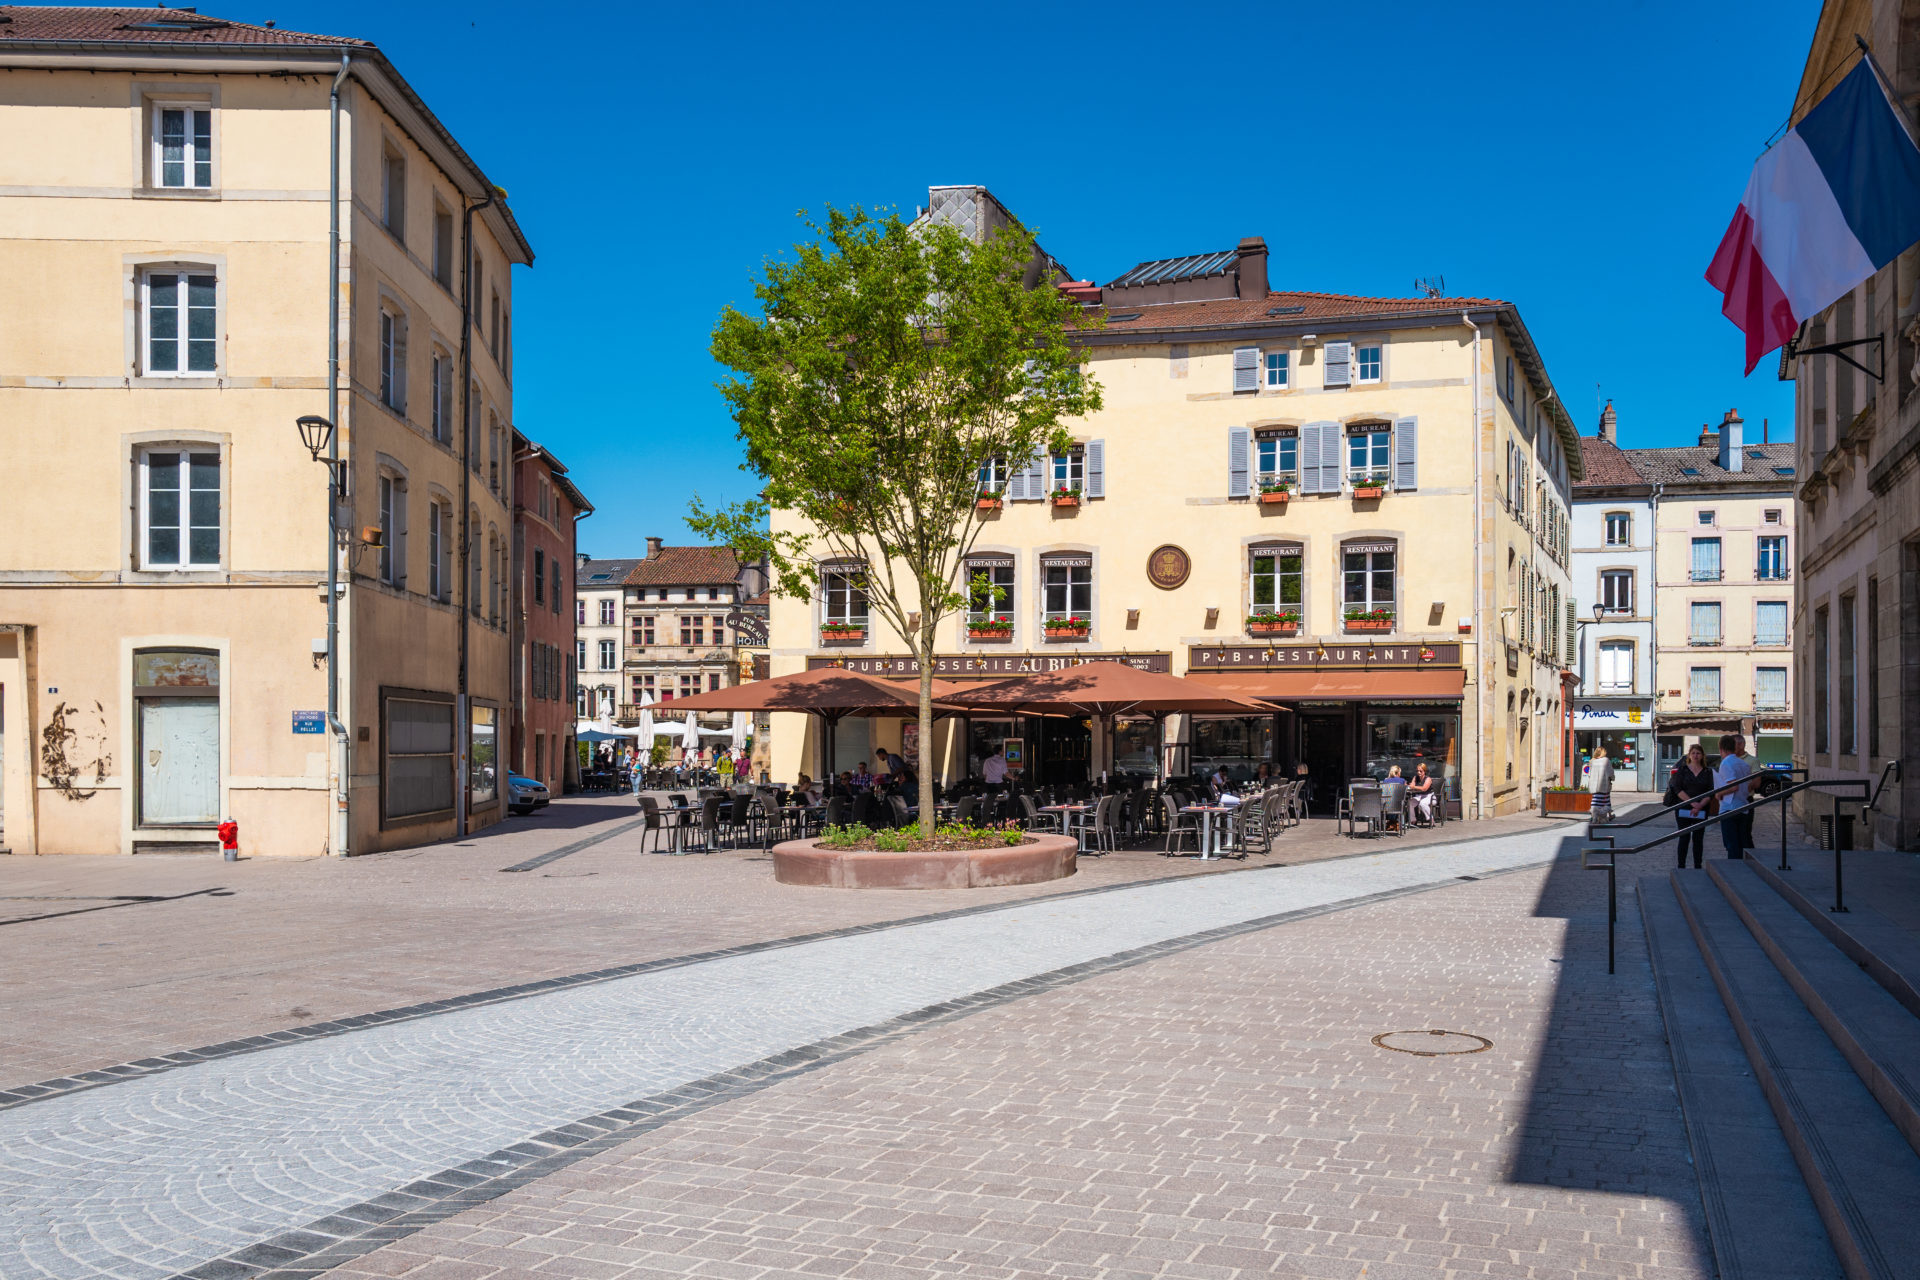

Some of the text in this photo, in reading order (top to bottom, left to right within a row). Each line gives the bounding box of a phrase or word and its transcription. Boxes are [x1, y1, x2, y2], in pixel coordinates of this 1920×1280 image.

[1269, 430, 1296, 438] BUREAU
[1361, 424, 1388, 432] BUREAU
[743, 616, 754, 624] PUB
[739, 621, 764, 639] BUREAU
[1262, 649, 1409, 661] RESTAURANT
[897, 659, 1012, 671] BRSSERIE
[1018, 658, 1043, 673] AU
[1582, 704, 1619, 720] Pinau
